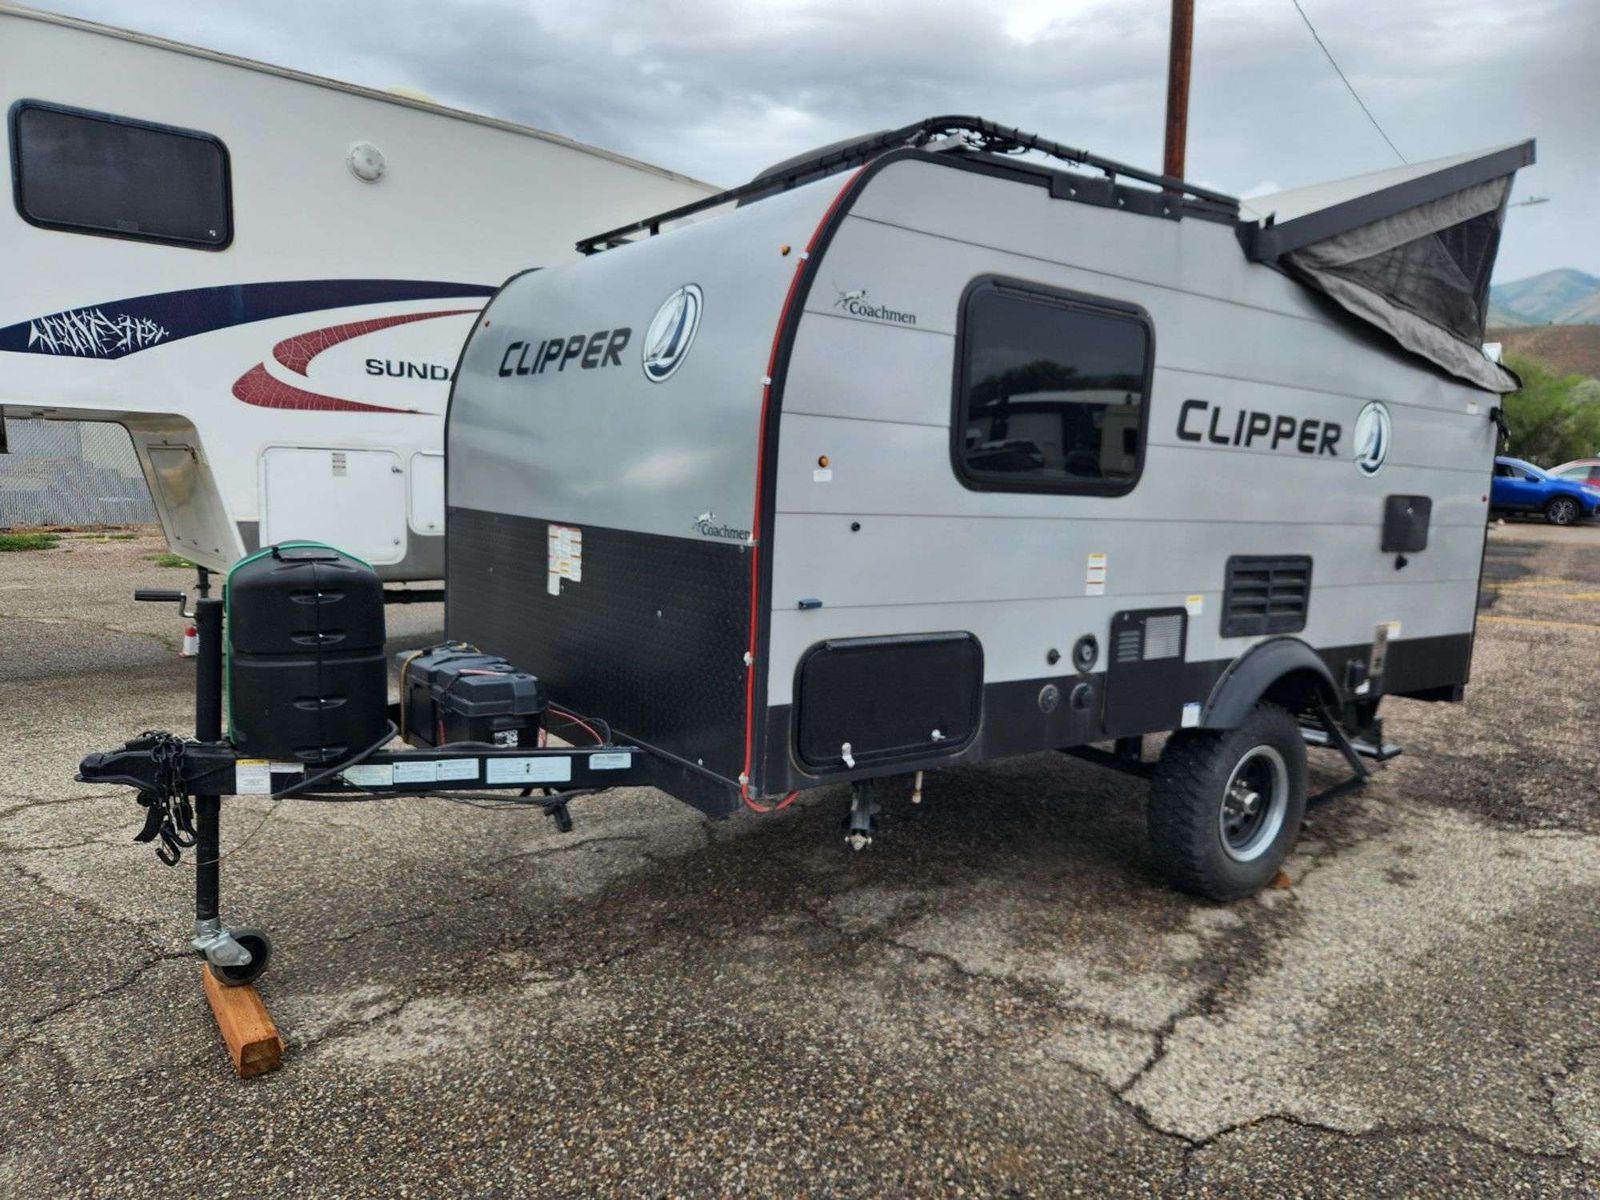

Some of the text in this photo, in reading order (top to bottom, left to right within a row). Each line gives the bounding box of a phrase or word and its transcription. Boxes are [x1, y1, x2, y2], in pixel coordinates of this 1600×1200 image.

[849, 301, 917, 325] Coachmen
[498, 327, 632, 378] CLIPPER
[365, 359, 453, 381] SUND
[1176, 399, 1342, 456] CLIPPER
[701, 523, 751, 541] Coachmen
